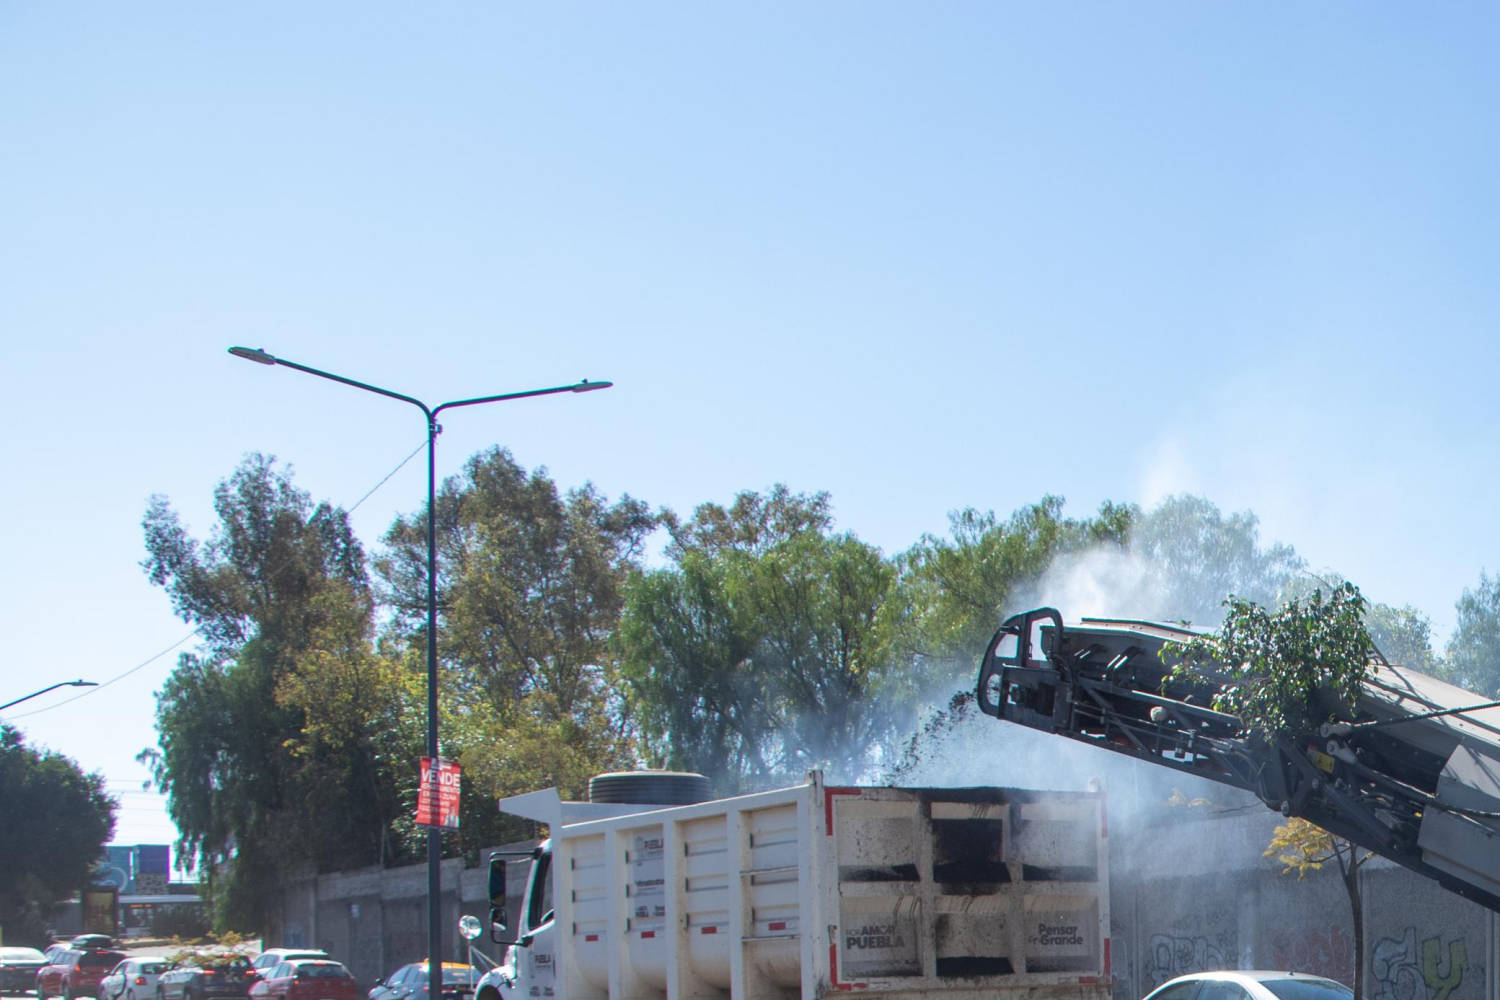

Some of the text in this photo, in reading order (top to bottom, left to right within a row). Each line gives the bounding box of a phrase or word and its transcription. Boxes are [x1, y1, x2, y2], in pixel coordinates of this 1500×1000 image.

[421, 768, 461, 787] VENDE
[1038, 922, 1079, 936] Pensar
[846, 935, 905, 950] PUEBLA
[1039, 933, 1084, 946] Grande
